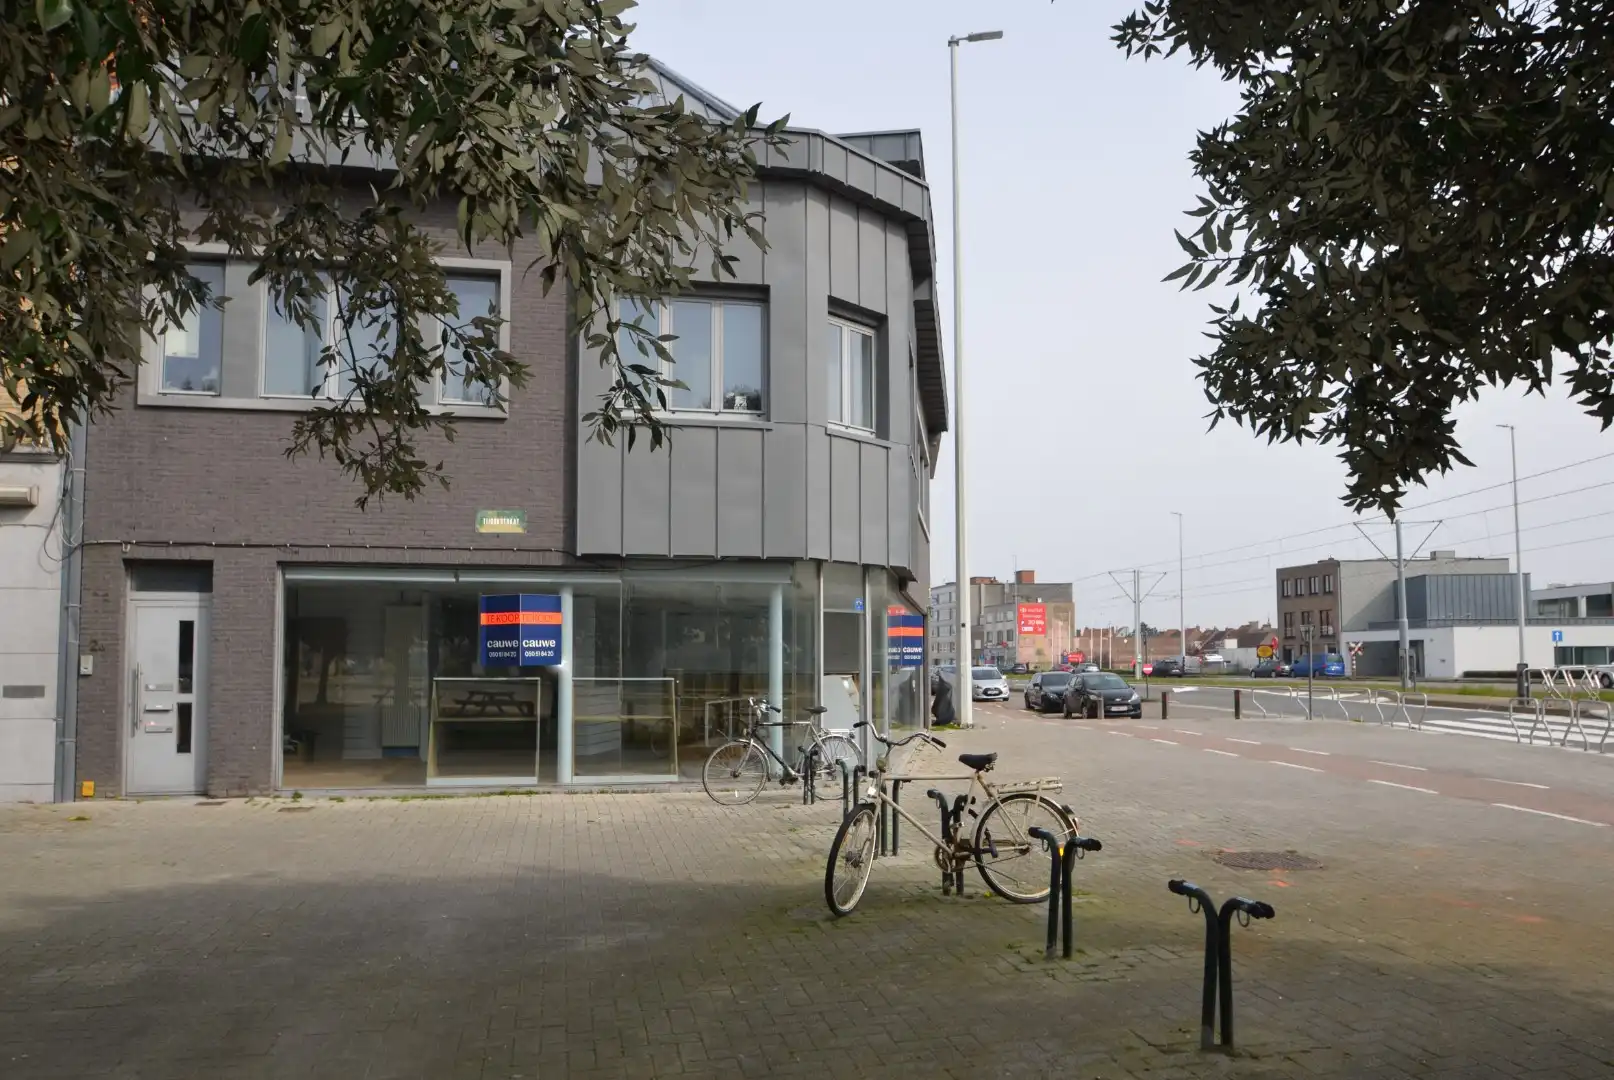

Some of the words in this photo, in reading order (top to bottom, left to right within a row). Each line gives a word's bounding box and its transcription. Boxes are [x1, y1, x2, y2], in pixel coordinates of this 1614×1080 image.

[487, 614, 495, 623] TE
[496, 613, 519, 623] KOOP
[487, 640, 519, 648] cauwe
[522, 639, 556, 648] cauwe
